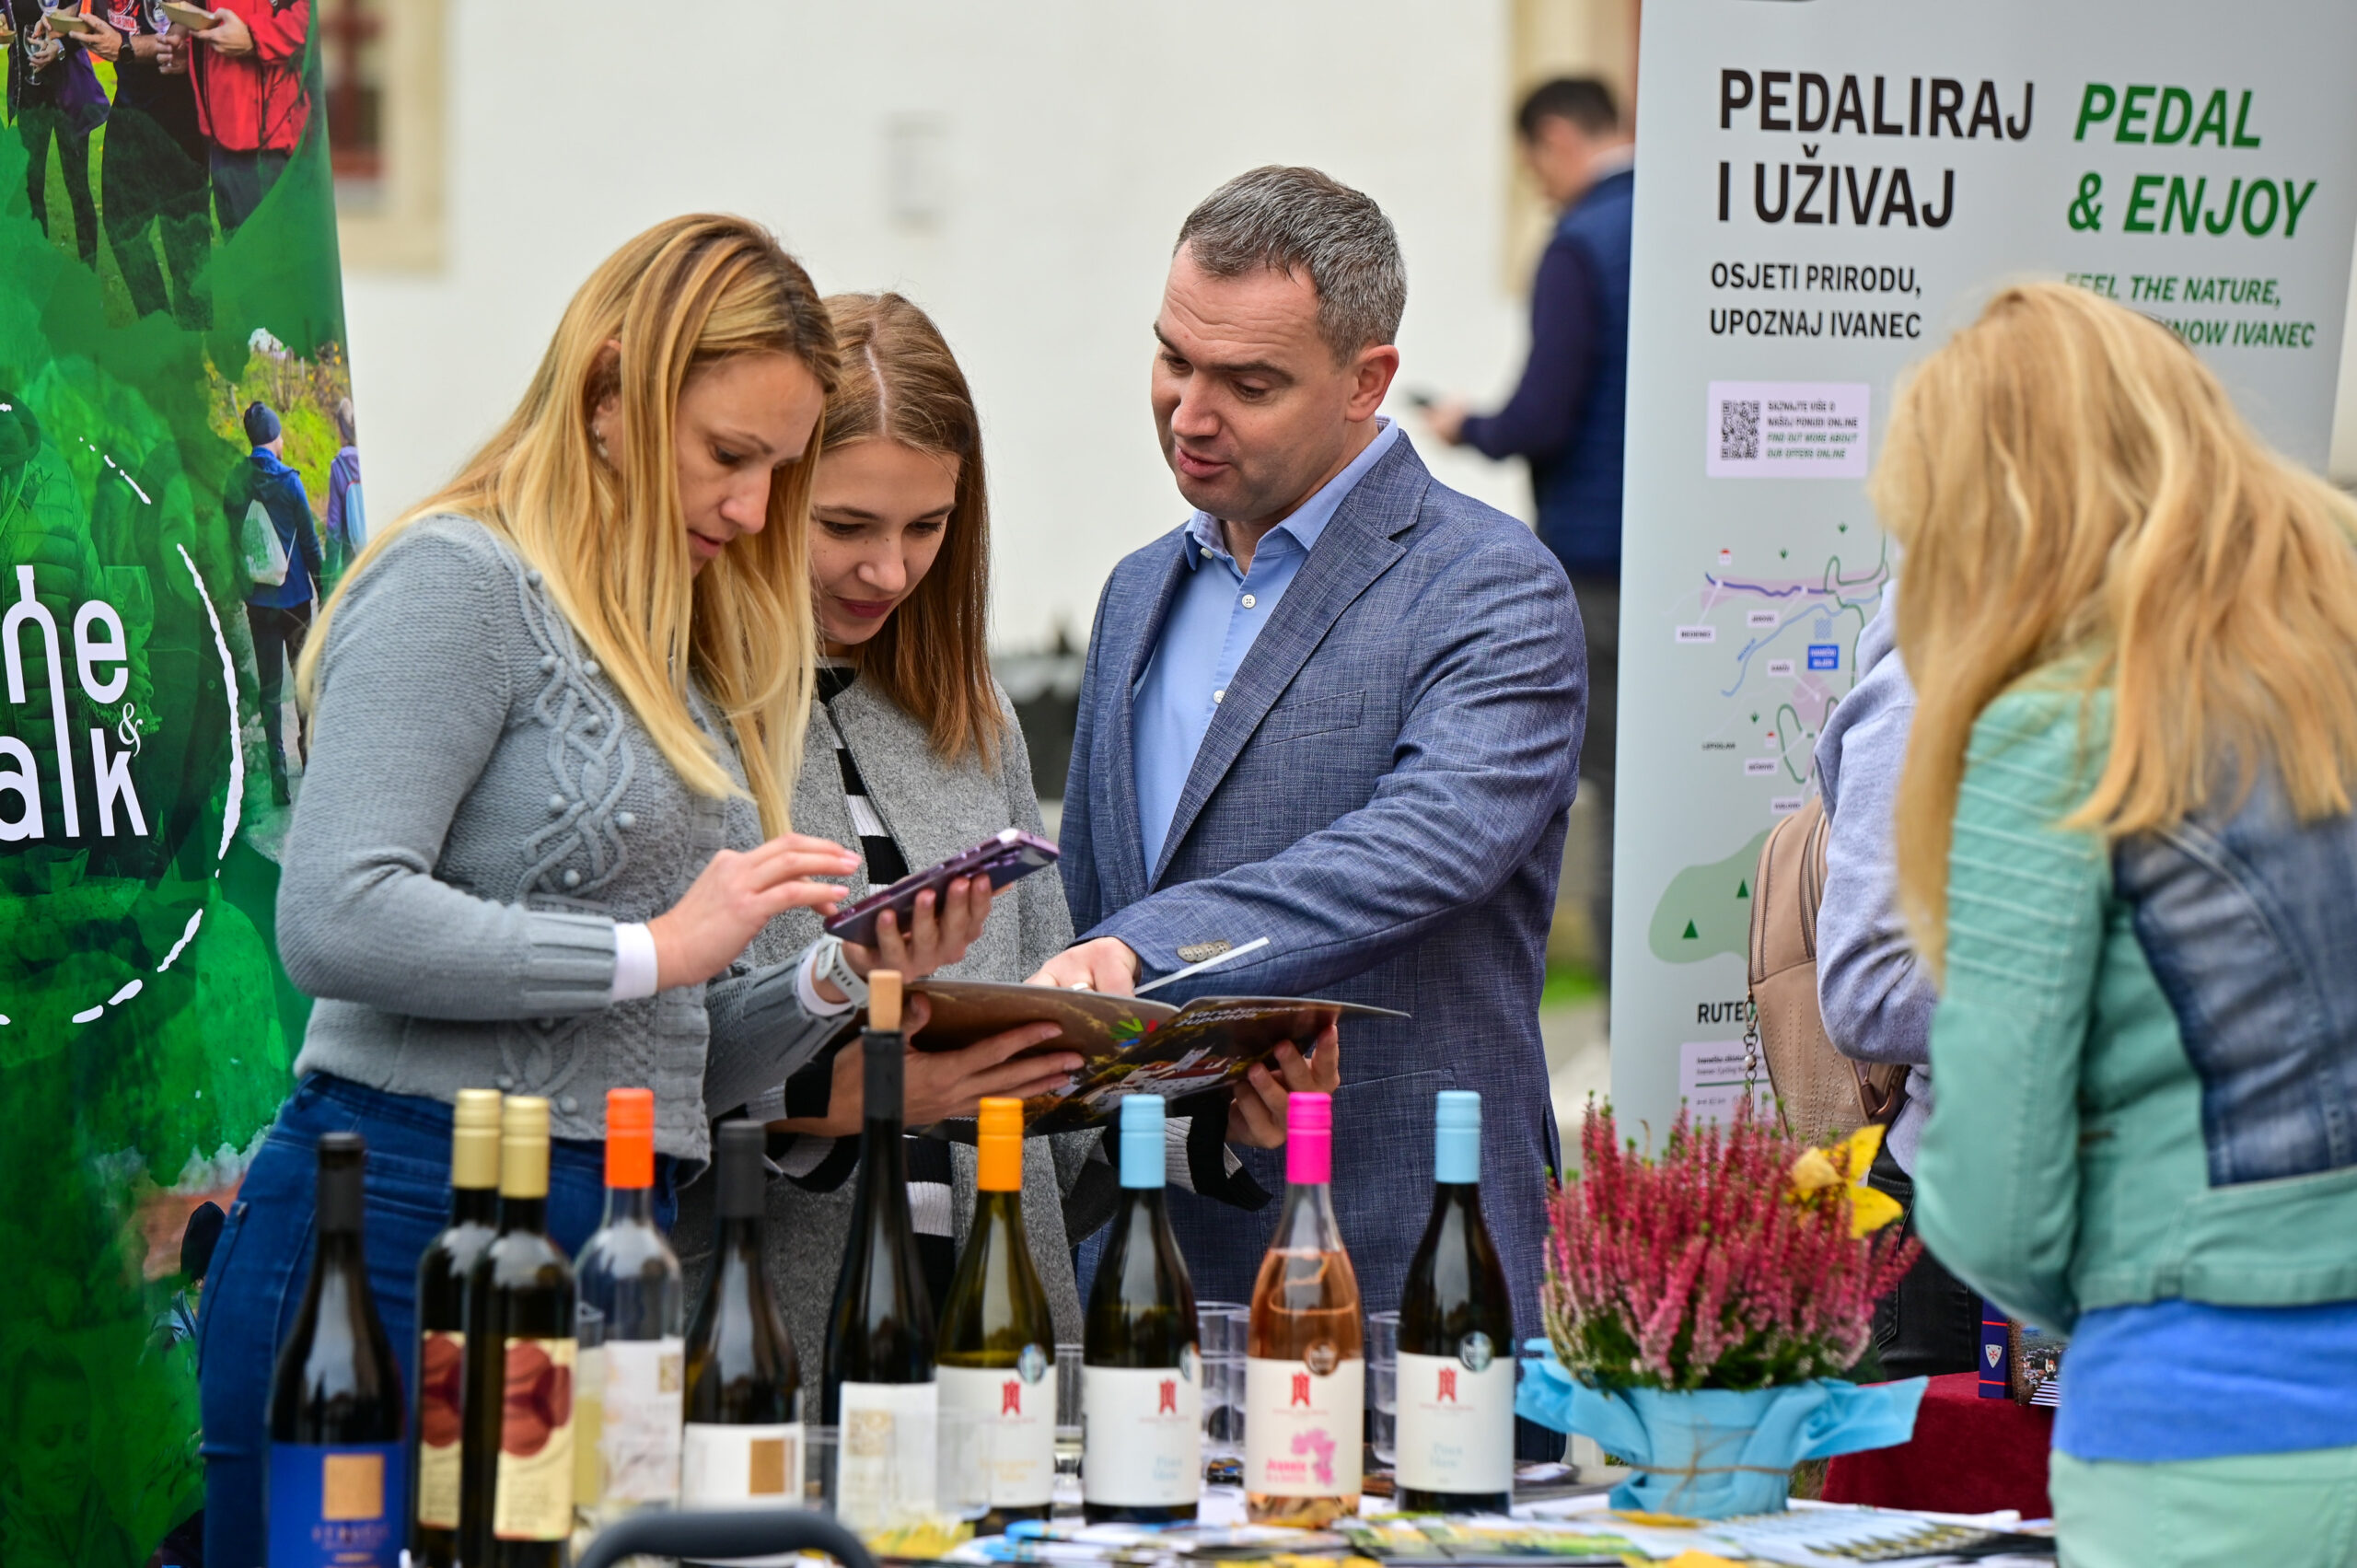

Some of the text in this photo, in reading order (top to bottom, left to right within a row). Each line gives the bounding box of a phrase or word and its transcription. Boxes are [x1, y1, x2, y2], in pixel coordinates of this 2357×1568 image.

[1721, 68, 2034, 141] PEDALIRAJ
[2073, 83, 2262, 148] PEDAL
[1718, 144, 1955, 228] I UŽIVAJ
[2068, 172, 2317, 238] & ENJOY
[1711, 262, 1922, 297] OSJETI PRIRODU,
[2131, 275, 2178, 302] THE
[2183, 278, 2282, 308] NATURE,
[1710, 309, 1922, 339] UPOZNAJ IVANEC
[2165, 319, 2316, 349] NOW IVANEC
[1697, 1001, 1745, 1025] RUTE
